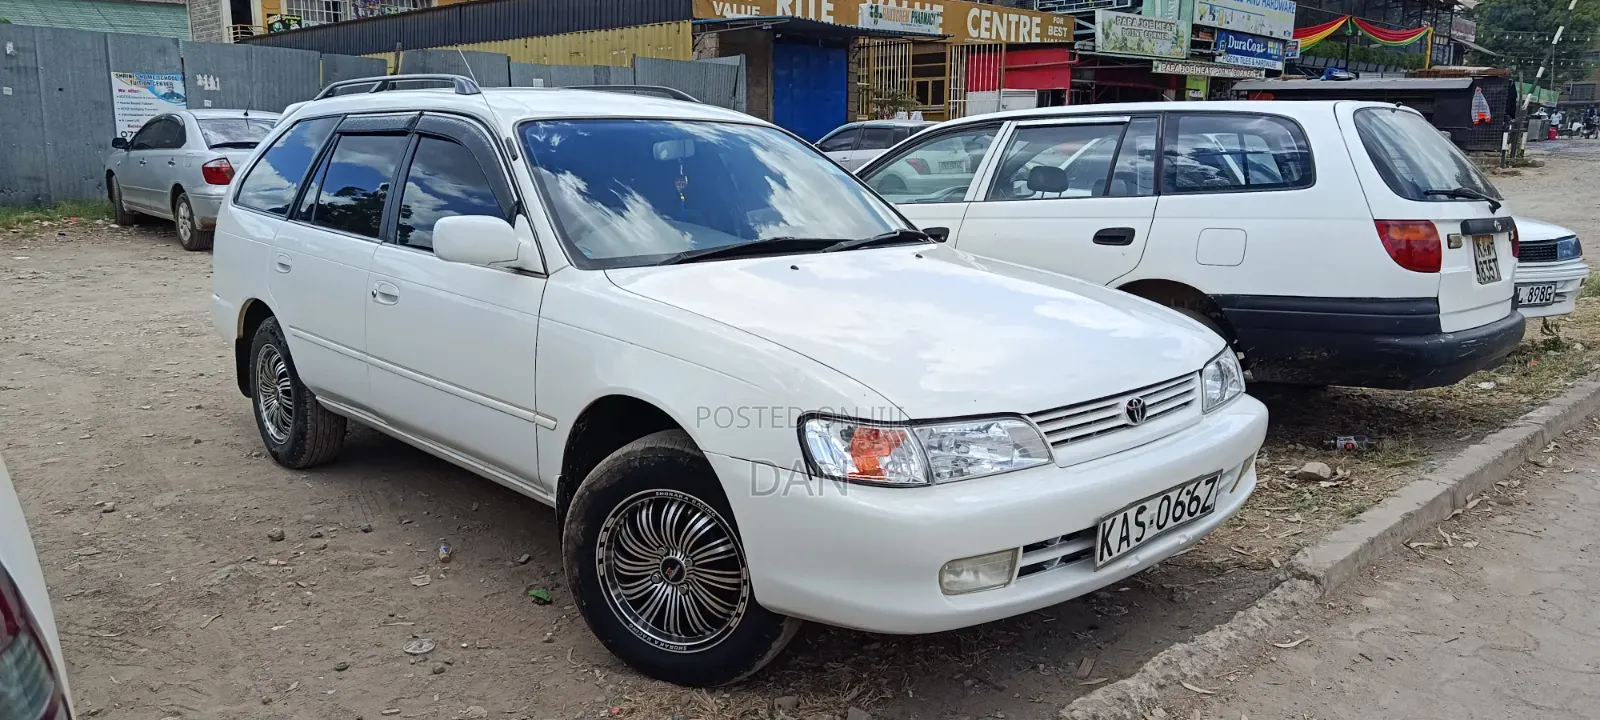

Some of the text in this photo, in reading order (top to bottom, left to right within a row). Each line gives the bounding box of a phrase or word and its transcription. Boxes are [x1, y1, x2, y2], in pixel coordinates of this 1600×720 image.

[713, 1, 760, 18] VALUE
[1262, 0, 1295, 14] HARDWARE
[911, 10, 937, 25] PHARMACY
[1116, 16, 1176, 32] PAPA JOE MEAT
[966, 8, 1042, 43] CENTRE
[1048, 26, 1068, 37] BEST
[1122, 27, 1169, 40] POINT CORNER
[1228, 35, 1266, 53] DuraCoat
[1161, 63, 1180, 73] PAPA
[1181, 64, 1194, 74] JOE
[1195, 65, 1213, 75] MEAT
[1232, 68, 1255, 78] CORNER
[1527, 286, 1554, 303] 898G
